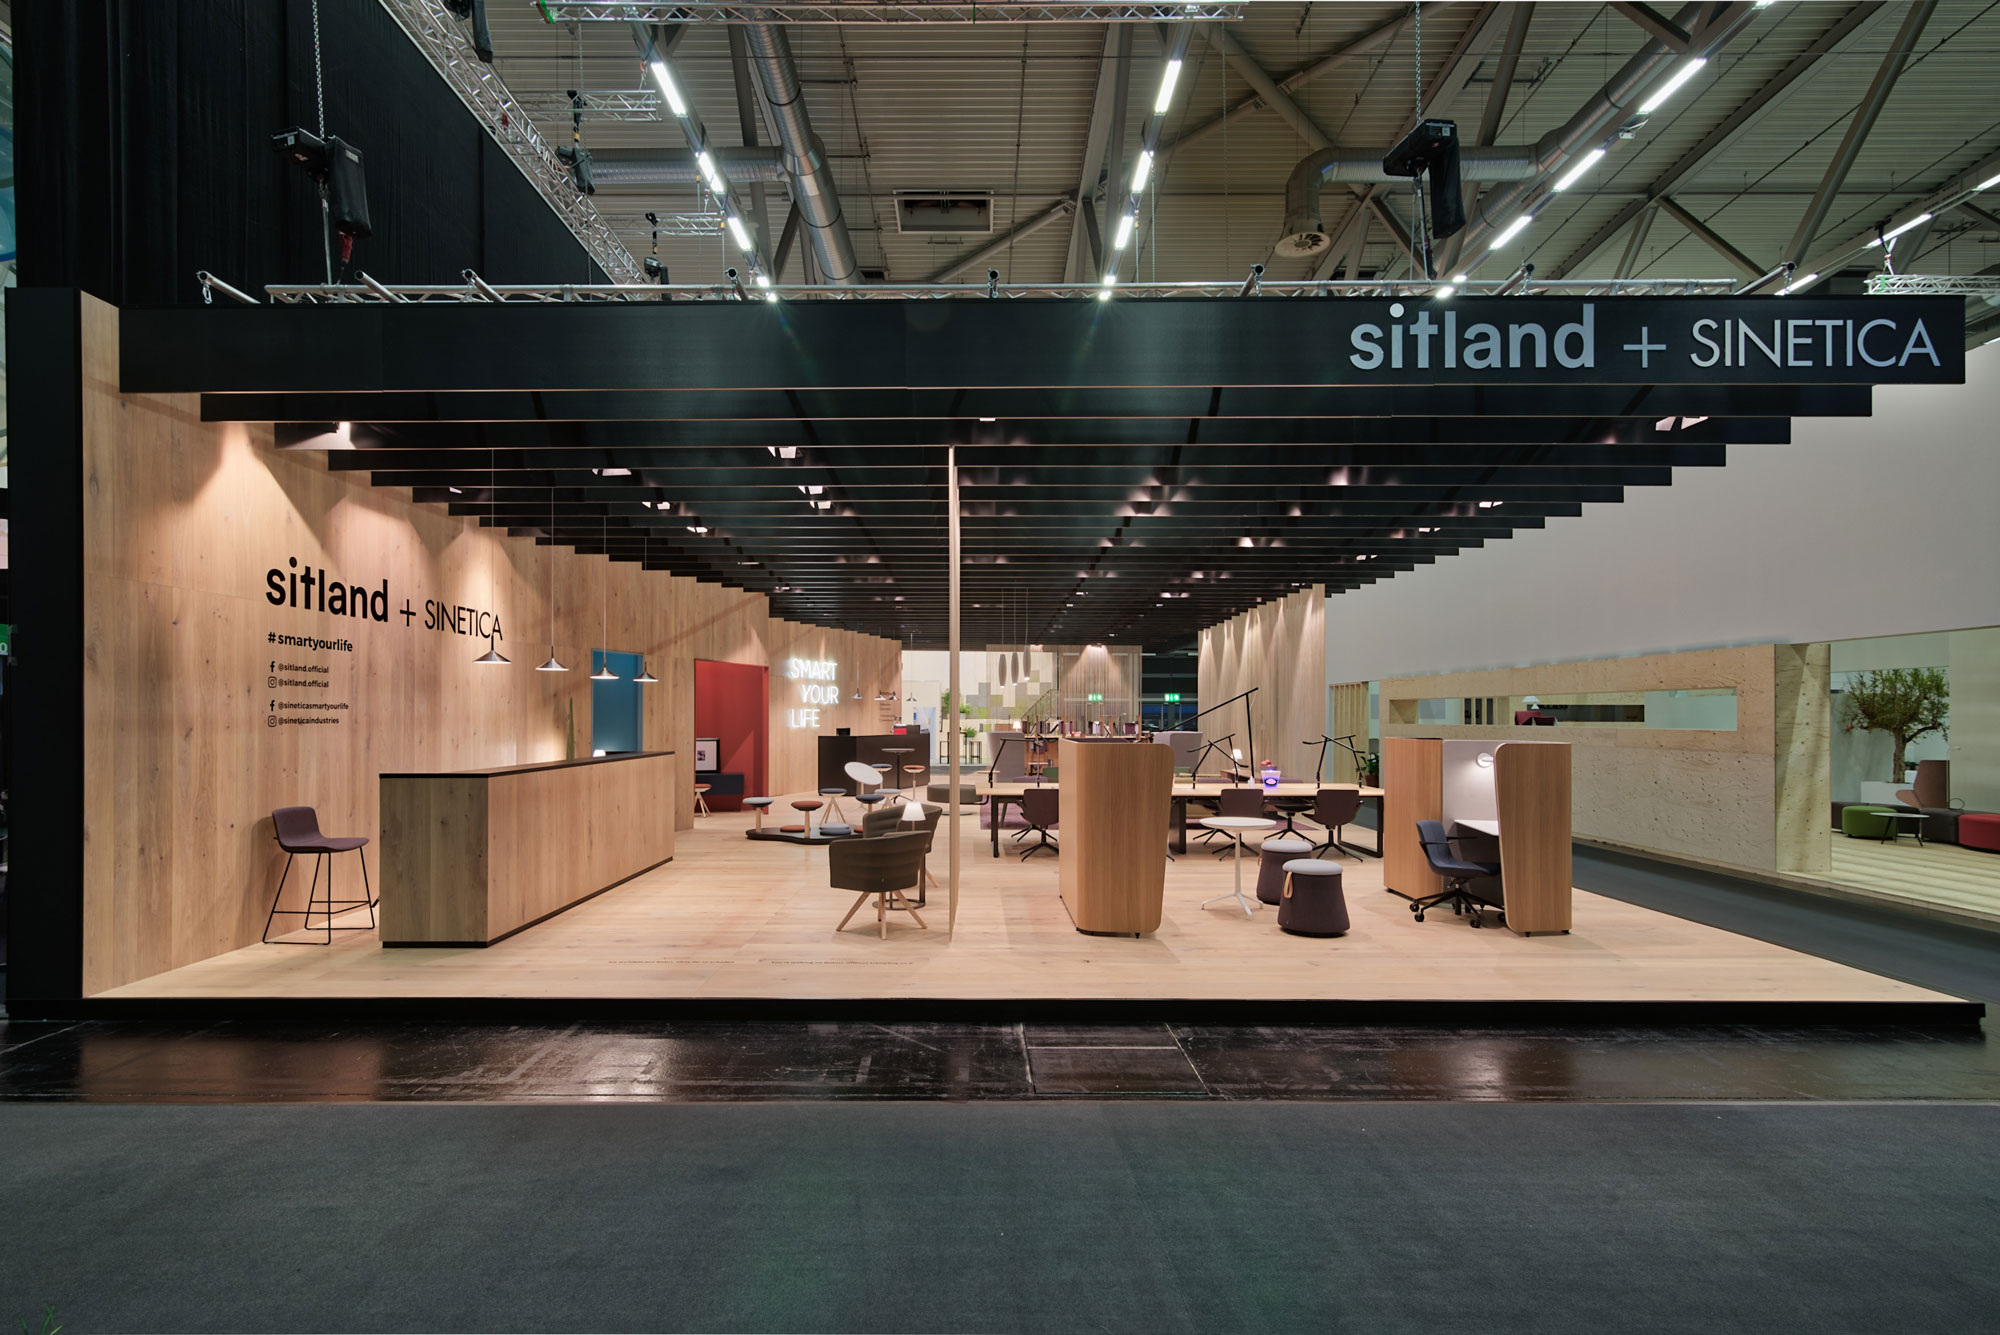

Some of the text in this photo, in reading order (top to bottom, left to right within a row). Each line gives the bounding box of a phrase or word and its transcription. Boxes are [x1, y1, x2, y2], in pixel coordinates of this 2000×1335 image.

[1349, 303, 1941, 370] sitland + SINETICA
[266, 556, 503, 641] sitland + SINETICA
[267, 631, 354, 653] #smartyourlife
[278, 662, 329, 674] @sitland.official
[790, 658, 838, 681] SMART
[278, 678, 329, 688] @sitland.official
[801, 684, 839, 704] YOUR
[278, 701, 349, 712] @sineticasmartyourlife
[278, 716, 340, 726] @sineticaindustries
[791, 708, 821, 728] LIFE
